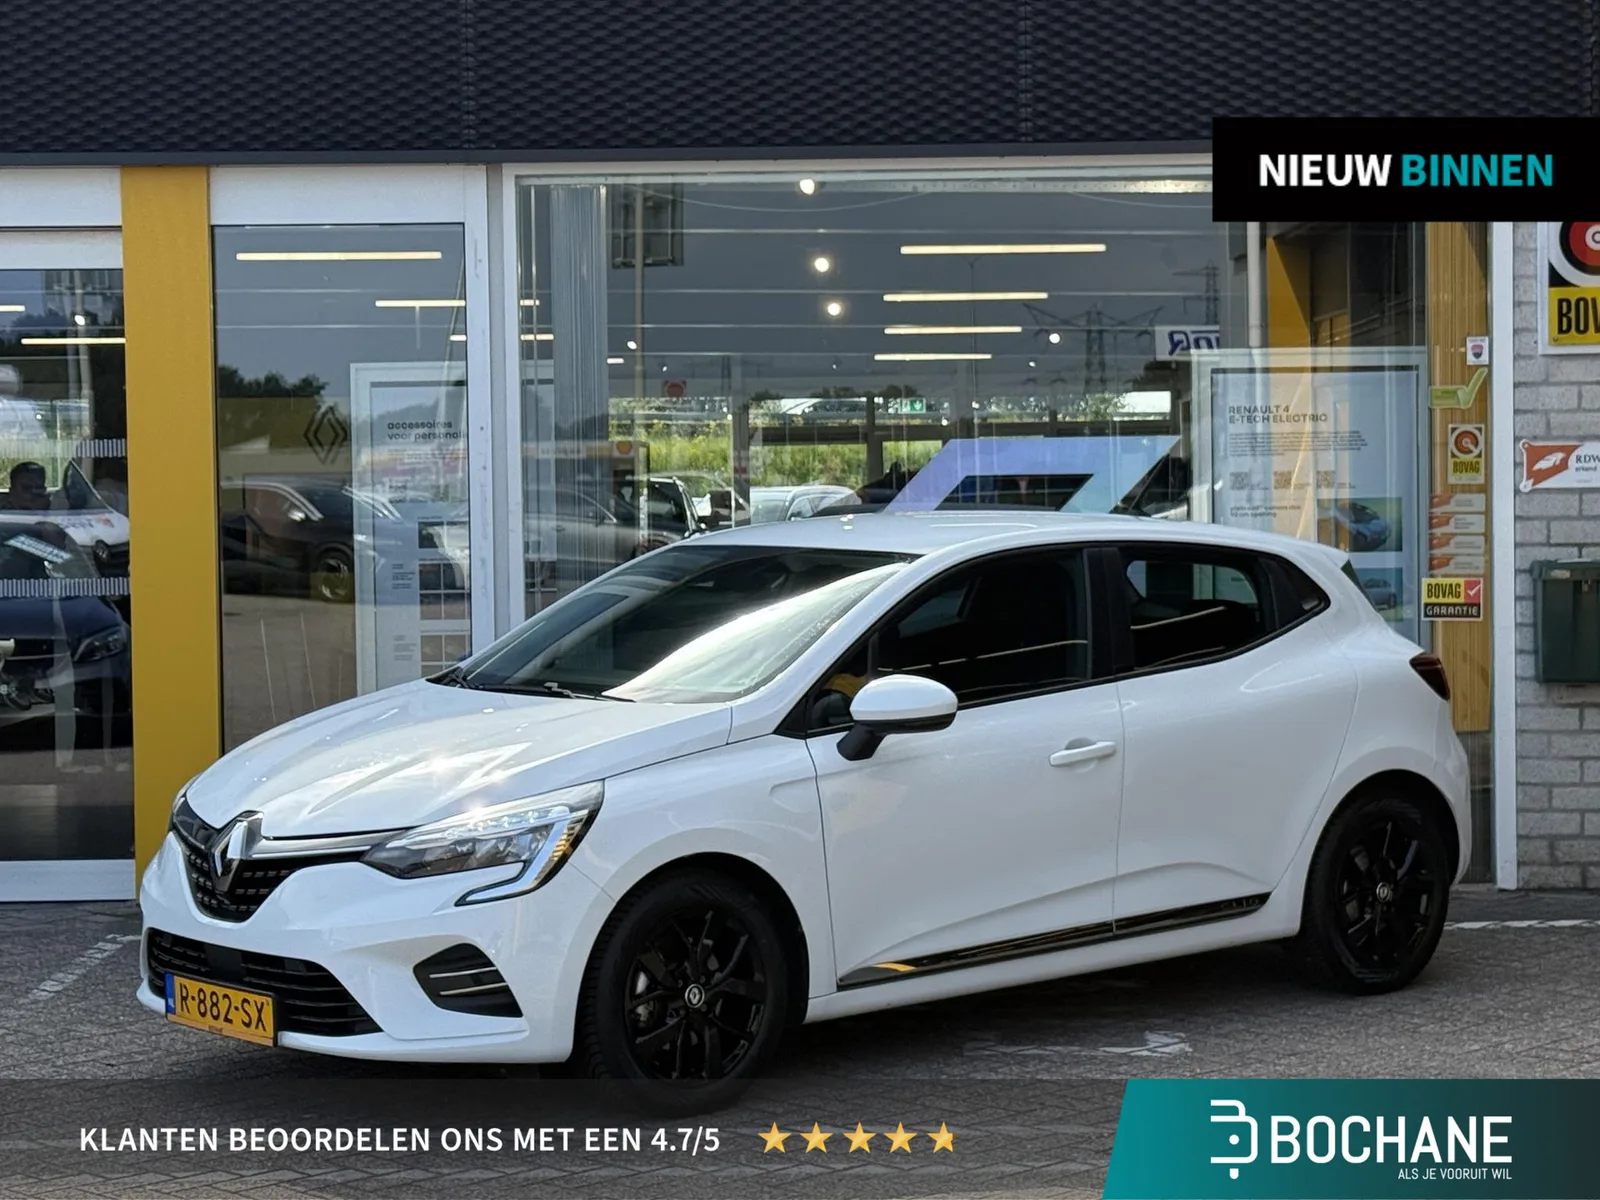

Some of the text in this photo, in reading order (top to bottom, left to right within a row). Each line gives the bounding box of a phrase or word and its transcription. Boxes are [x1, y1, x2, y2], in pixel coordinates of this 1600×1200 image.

[1228, 404, 1290, 415] RENAULT 4
[387, 420, 453, 430] accessoires
[1228, 414, 1270, 424] E-TECH
[387, 432, 411, 441] voor
[1452, 461, 1480, 474] BOVAG
[1426, 582, 1461, 600] BOVAG
[1426, 604, 1479, 617] GARANTIE
[179, 982, 267, 1032] R-882-SX
